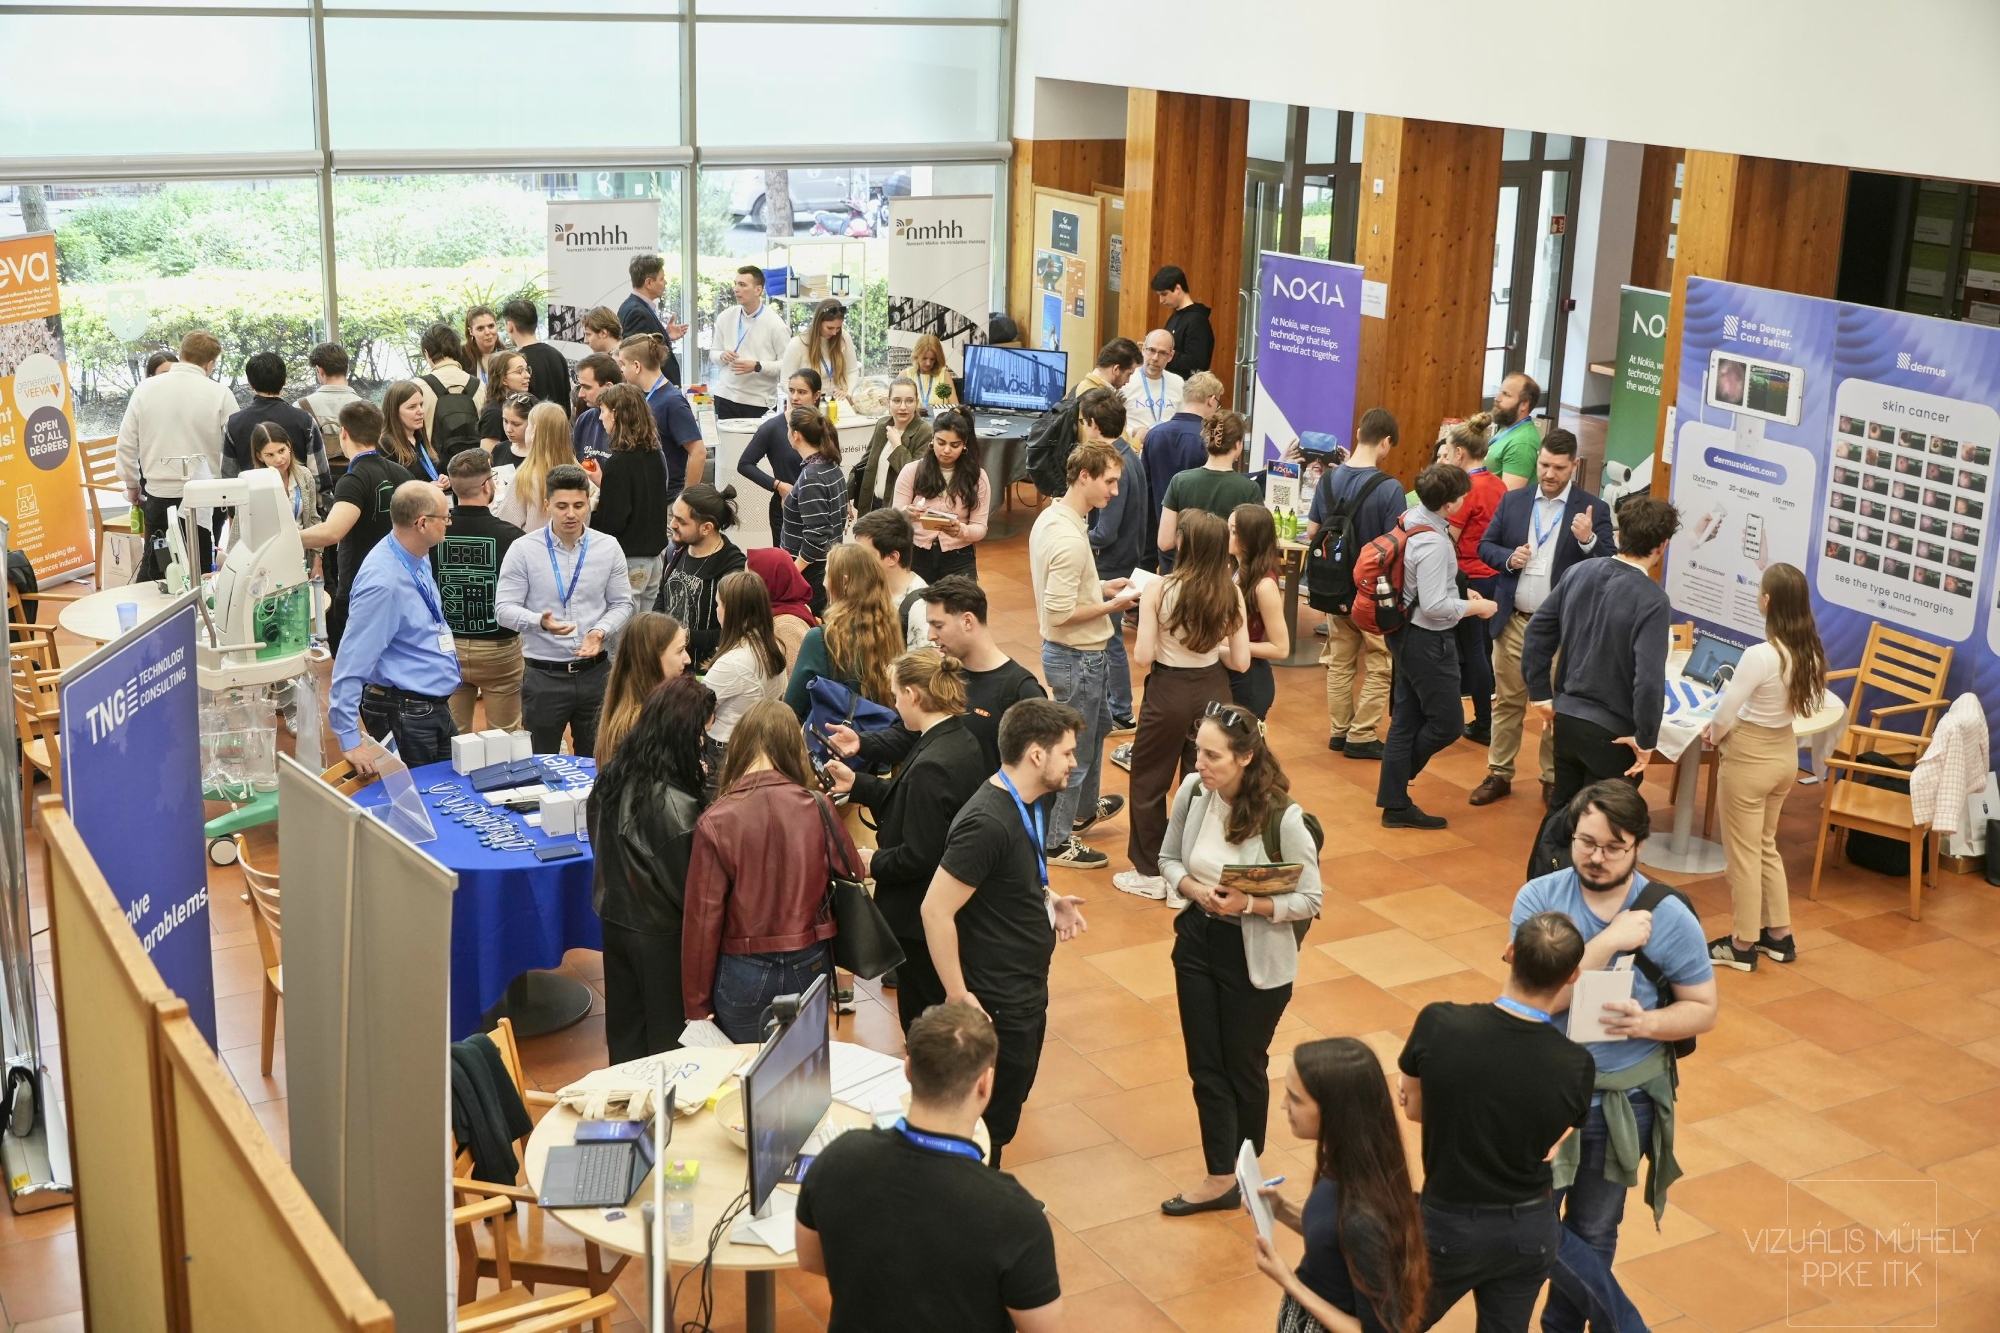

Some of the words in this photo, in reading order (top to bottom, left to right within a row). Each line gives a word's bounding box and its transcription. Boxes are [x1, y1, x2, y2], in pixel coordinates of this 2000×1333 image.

[566, 224, 628, 246] nmhh
[906, 220, 962, 240] nmhh
[1272, 274, 1345, 308] NOKIA
[1271, 316, 1279, 326] At
[1280, 318, 1299, 330] Nokia,
[1300, 323, 1310, 331] we
[1310, 325, 1331, 336] create
[1741, 320, 1757, 330] See
[1760, 323, 1793, 338] Deeper.
[1270, 329, 1305, 344] technology
[1306, 335, 1320, 346] that
[1321, 337, 1338, 350] helps
[1740, 332, 1761, 344] Care
[1762, 337, 1792, 350] Better.
[1269, 340, 1280, 351] the
[1282, 344, 1299, 354] world
[1300, 348, 1311, 357] act
[1312, 350, 1340, 362] together.
[1629, 354, 1636, 365] At
[1637, 356, 1656, 370] Nokia,
[1910, 361, 1946, 377] dermus
[16, 374, 60, 394] generation
[1628, 368, 1661, 385] technology
[24, 385, 51, 398] VEEVA
[1626, 380, 1637, 391] the
[1638, 382, 1654, 395] world
[1882, 400, 1905, 414] skin
[1909, 407, 1950, 423] cancer
[34, 419, 58, 433] OPEN
[32, 434, 45, 445] TO
[47, 430, 63, 441] ALL
[30, 439, 68, 457] DEGREES
[1713, 455, 1778, 478] dermusvision.com
[1693, 474, 1706, 484] 12x12
[1747, 490, 1760, 498] MHz
[18, 518, 40, 529] SOFTWARE
[17, 533, 45, 546] DEVELOPMENT
[29, 556, 44, 566] ation
[45, 548, 66, 560] shaping
[67, 545, 76, 555] the
[34, 563, 58, 575] Sciences
[59, 554, 83, 568] industry!
[1698, 564, 1725, 577] skinscanner
[1835, 573, 1850, 584] see
[1852, 578, 1868, 590] the
[1870, 583, 1890, 596] type
[1892, 591, 1912, 603] and
[1914, 596, 1954, 616] margins
[1888, 604, 1917, 617] skinscanner
[86, 688, 126, 745] TNG
[138, 646, 185, 686] TECHNOLOGY
[140, 666, 186, 707] CONSULTING
[126, 894, 150, 927] olve
